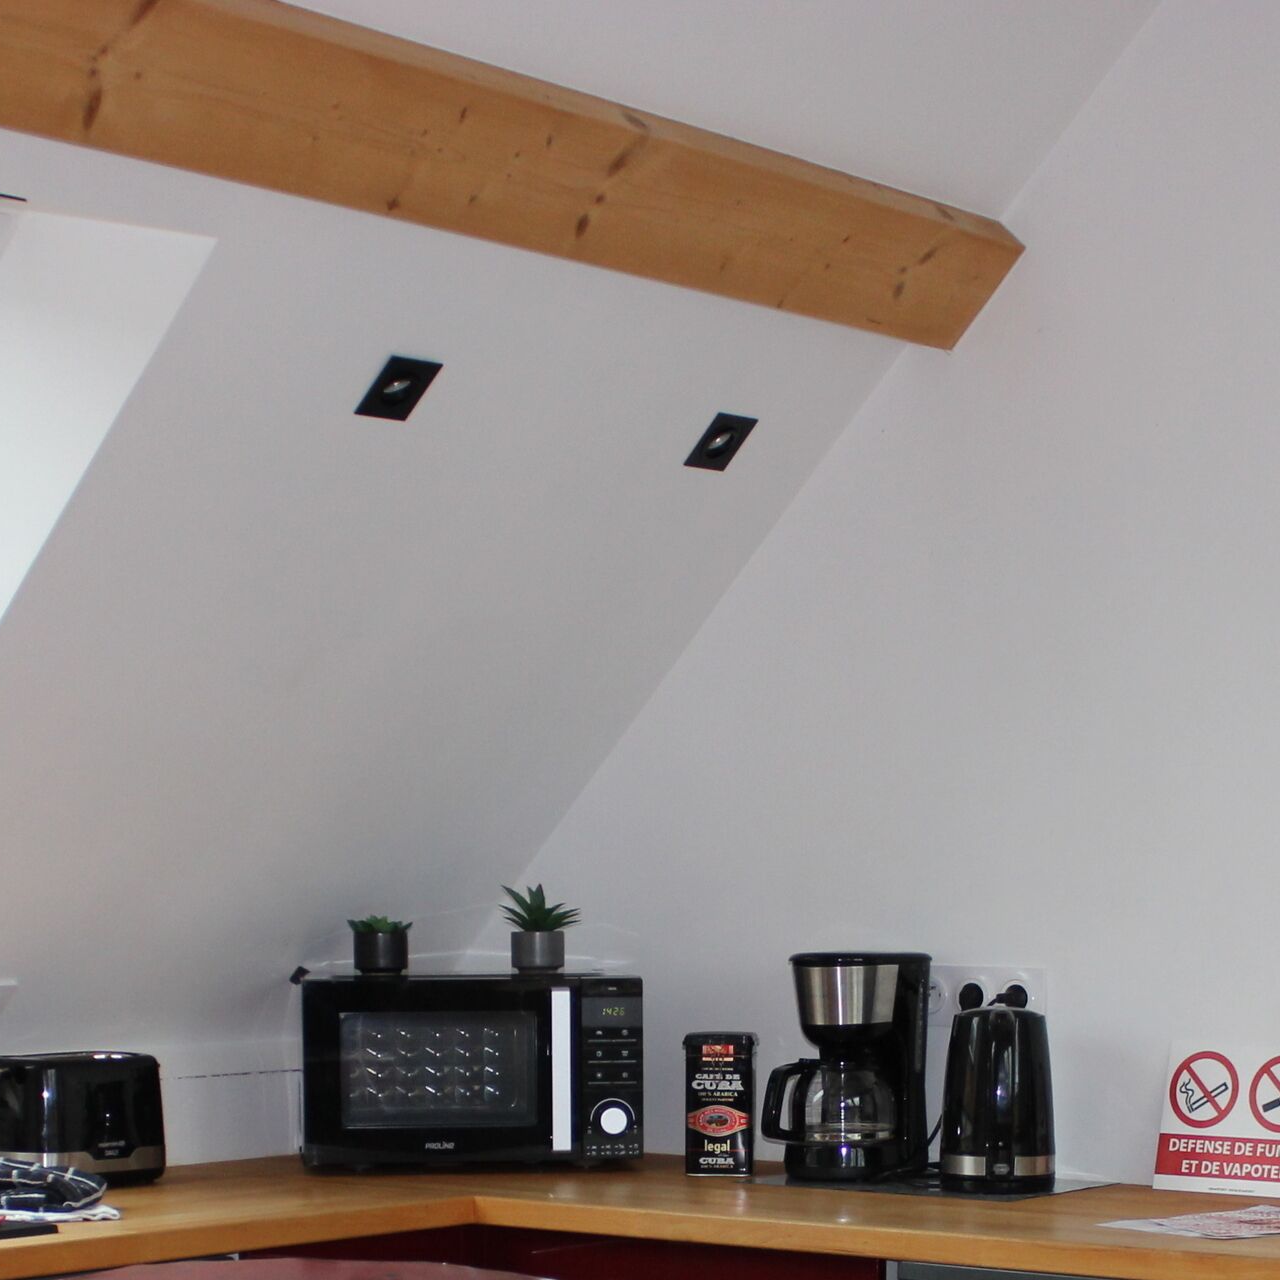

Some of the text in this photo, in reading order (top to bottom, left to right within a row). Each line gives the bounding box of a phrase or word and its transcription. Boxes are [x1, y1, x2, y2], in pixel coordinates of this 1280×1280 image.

[691, 1080, 744, 1091] CUBA
[704, 1139, 730, 1154] legal
[1168, 1138, 1232, 1155] DEFENSE
[1234, 1141, 1254, 1156] DE
[699, 1157, 735, 1165] CUBA
[1181, 1159, 1199, 1173] ET
[1201, 1161, 1221, 1174] DE
